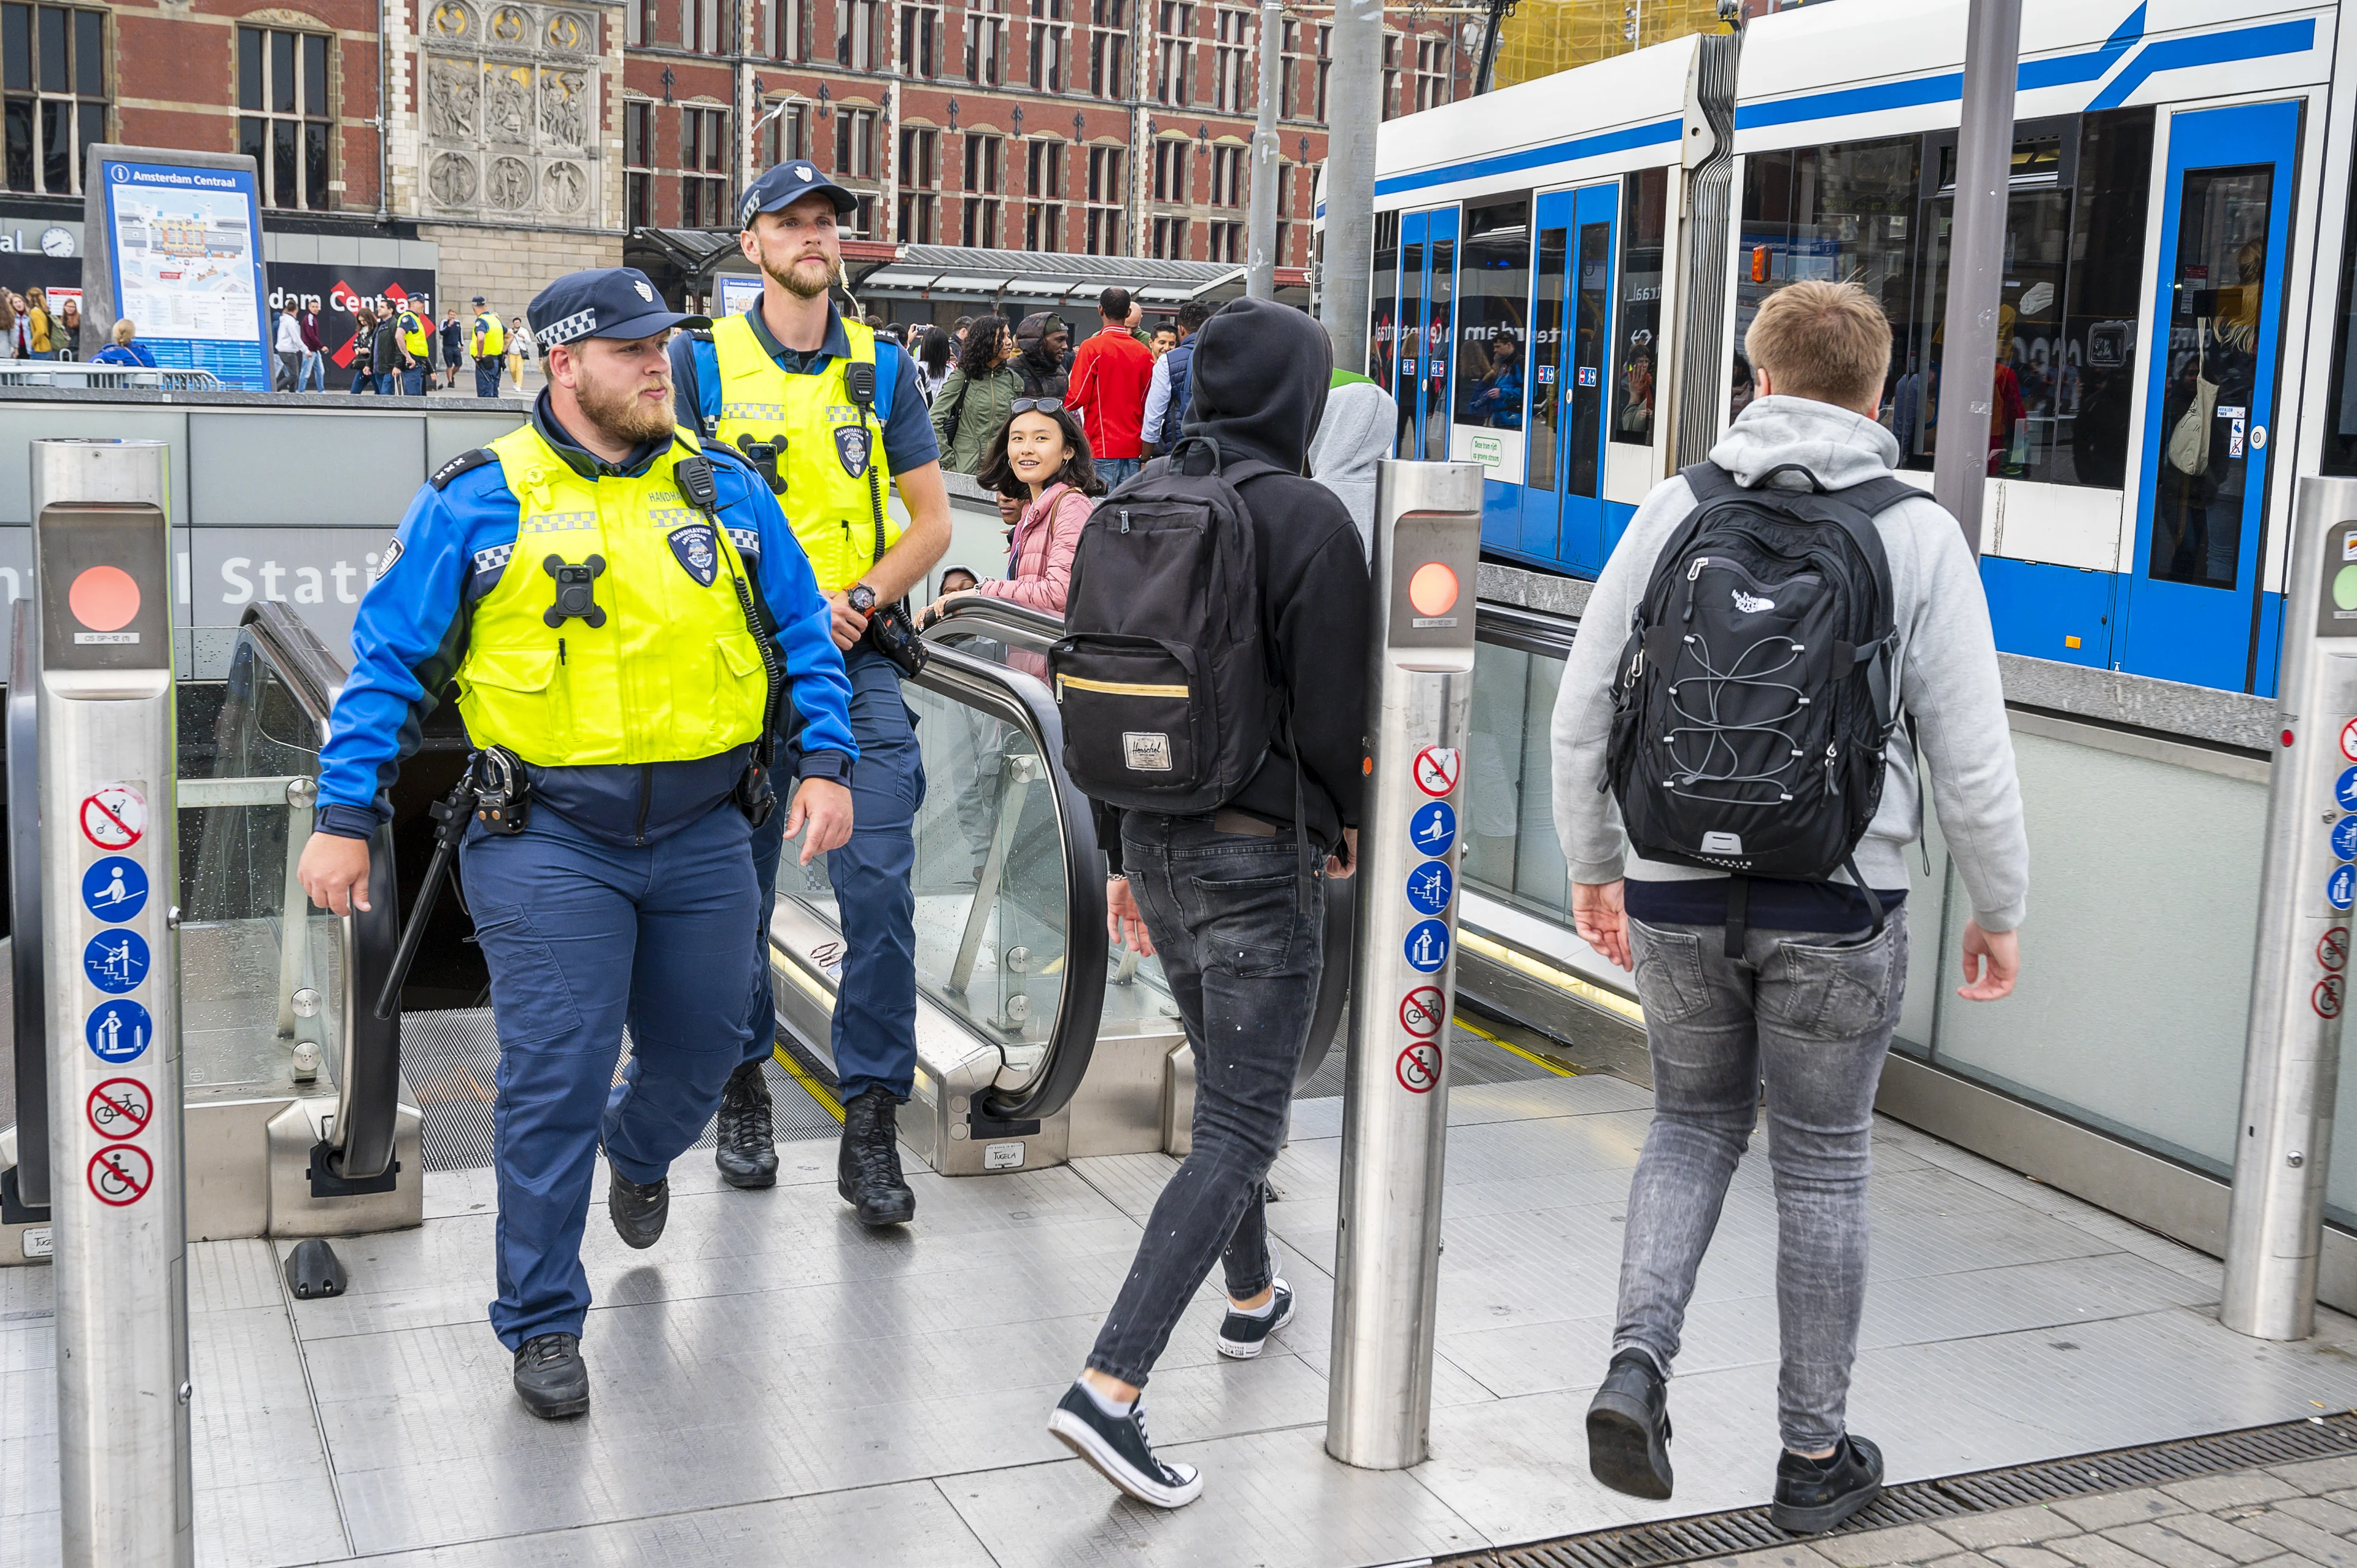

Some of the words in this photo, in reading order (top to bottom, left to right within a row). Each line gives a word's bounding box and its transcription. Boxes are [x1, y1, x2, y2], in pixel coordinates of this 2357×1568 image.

[133, 171, 192, 185] Amsterdam
[193, 175, 236, 188] Centraal
[671, 528, 712, 542] HANDHAVING
[1132, 741, 1161, 755] Herschel
